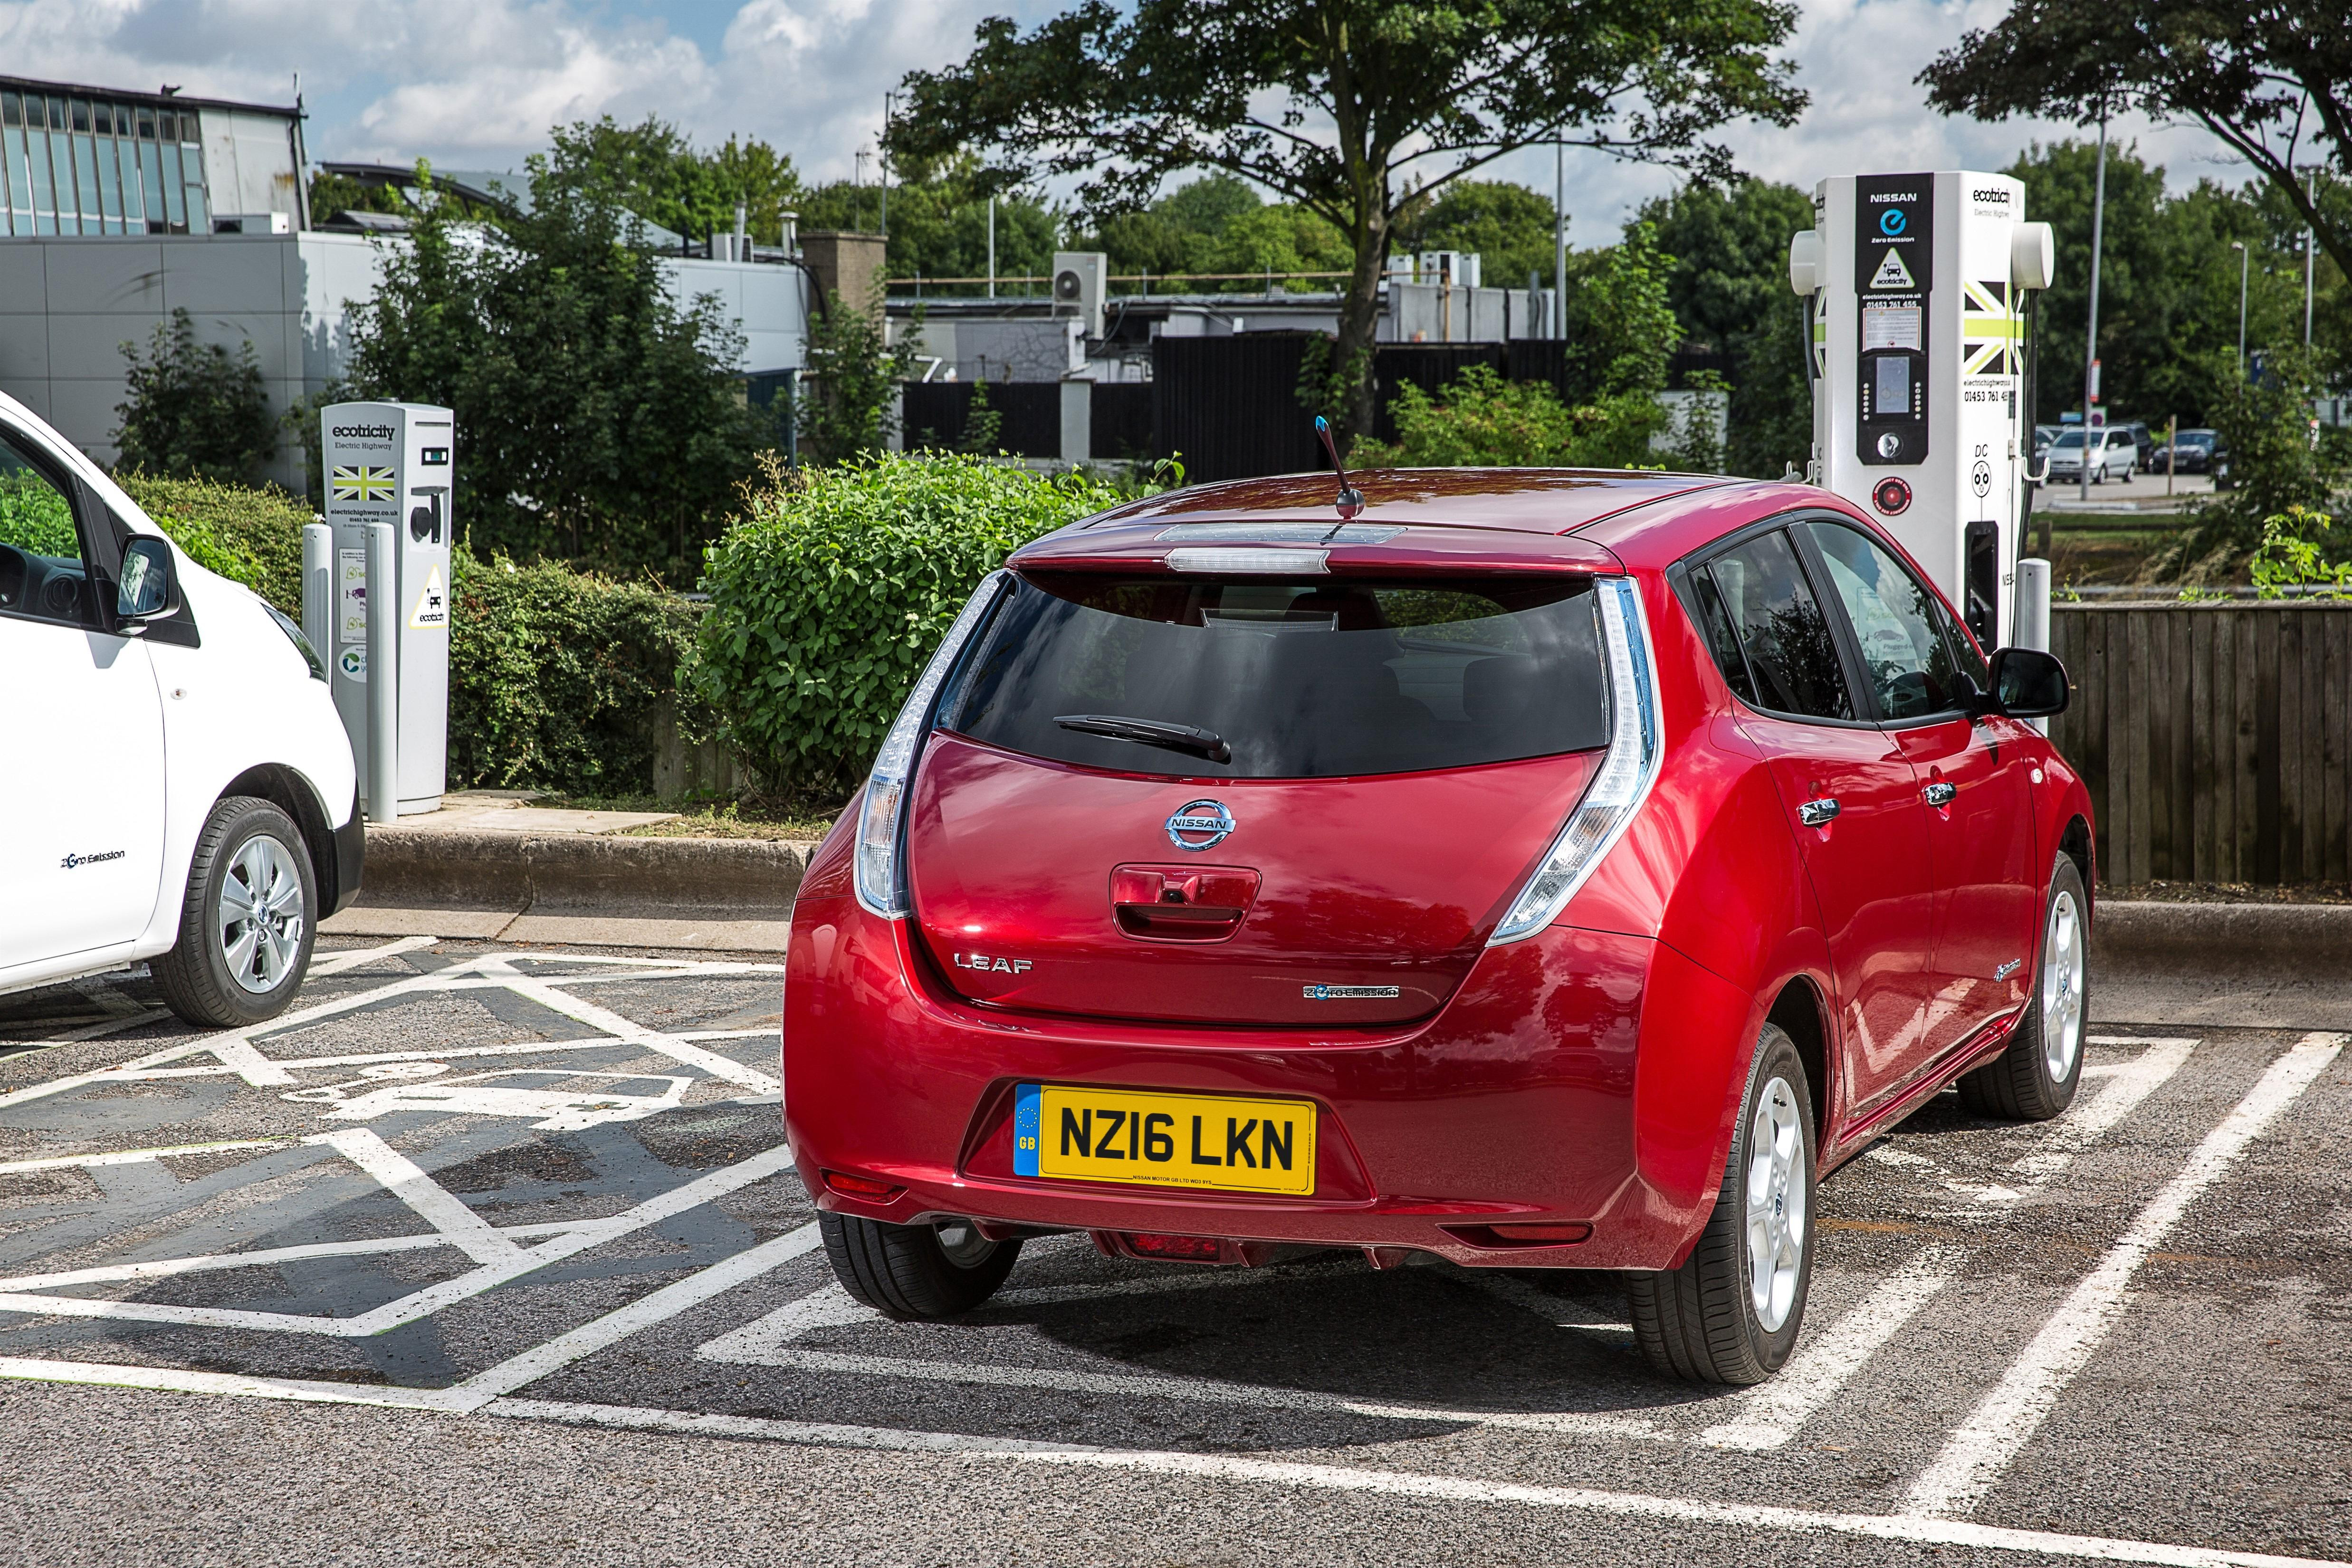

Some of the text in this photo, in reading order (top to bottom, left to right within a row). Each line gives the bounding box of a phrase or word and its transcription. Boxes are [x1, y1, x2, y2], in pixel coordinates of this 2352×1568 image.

[1870, 193, 1917, 203] NISSAN
[1964, 392, 1985, 402] 01453
[1988, 391, 1998, 402] 761
[332, 424, 395, 441] ecotricity
[362, 442, 392, 451] Highway
[1975, 444, 1988, 457] DC
[1171, 819, 1226, 829] NISSAN
[87, 851, 125, 863] Emission
[954, 953, 1032, 974] LEAF
[1019, 1136, 1035, 1150] GB
[1060, 1107, 1174, 1162] NZ16
[1191, 1115, 1293, 1171] LKN
